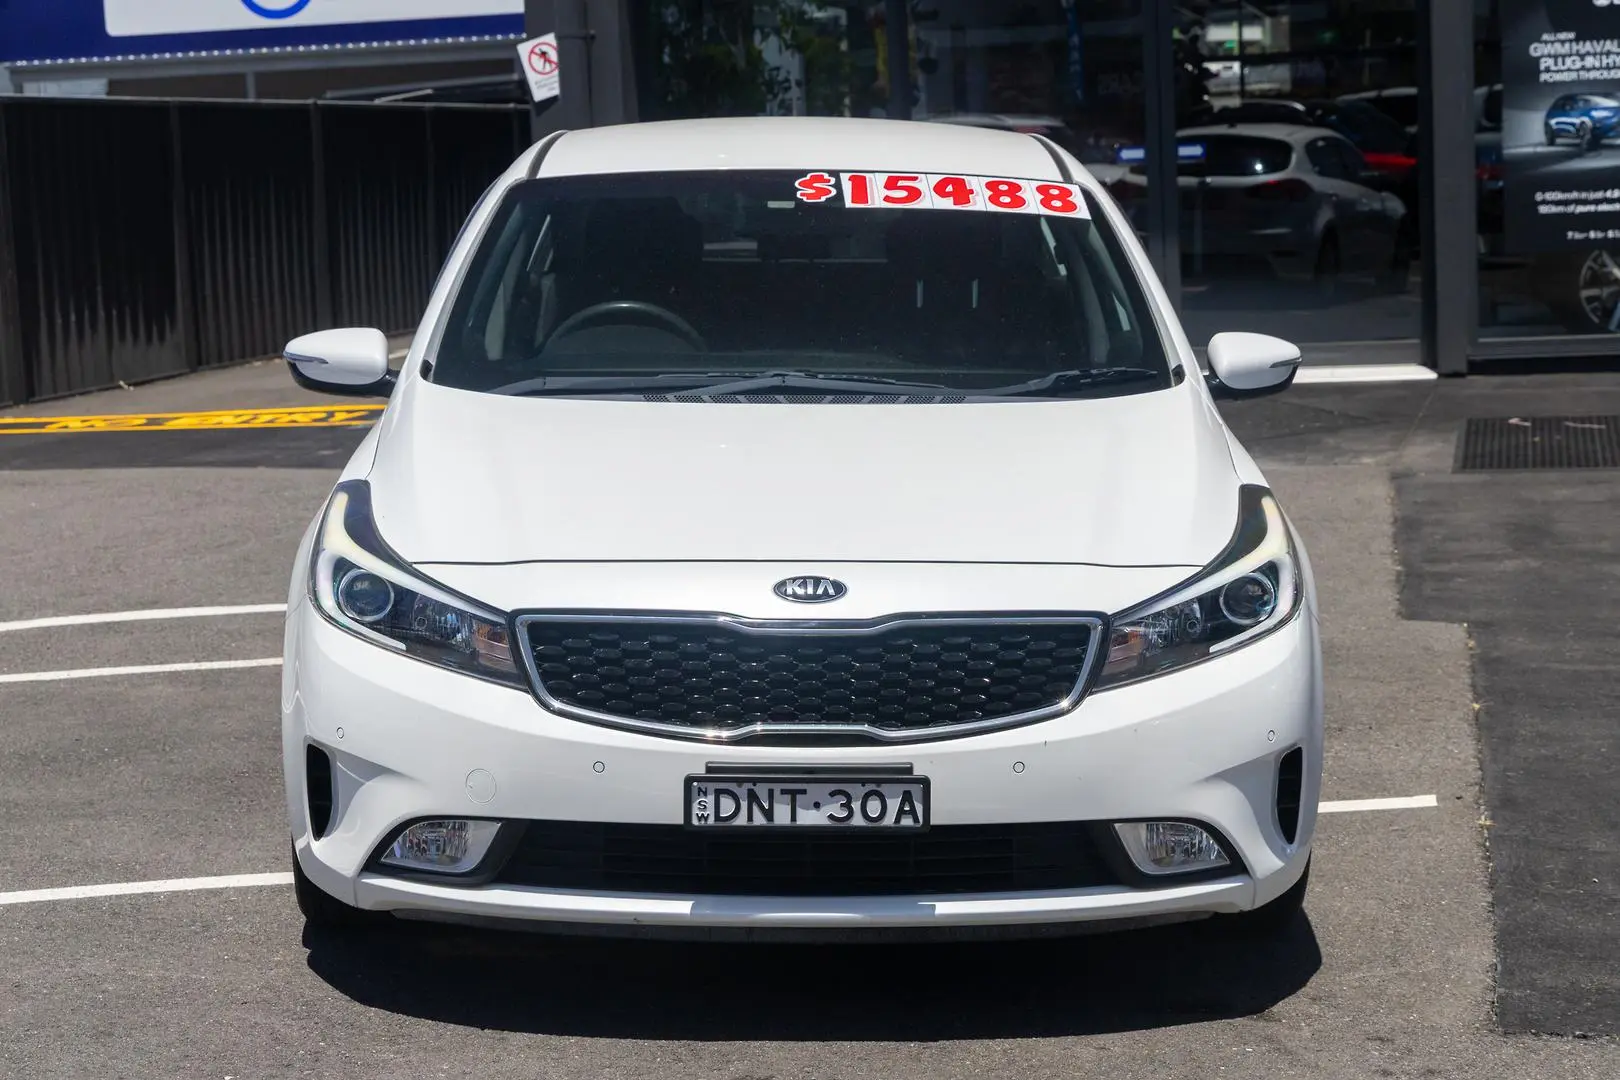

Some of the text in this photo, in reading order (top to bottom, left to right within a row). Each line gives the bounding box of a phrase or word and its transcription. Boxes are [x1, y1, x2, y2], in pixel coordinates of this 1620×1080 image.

[1528, 39, 1620, 57] GWM HAVAL
[1539, 54, 1600, 71] PLUG-IN
[1539, 71, 1578, 83] POWER
[795, 172, 1083, 215] $15488
[43, 411, 370, 430] NO ENTRY
[785, 579, 836, 596] KIA
[695, 786, 711, 824] NSW
